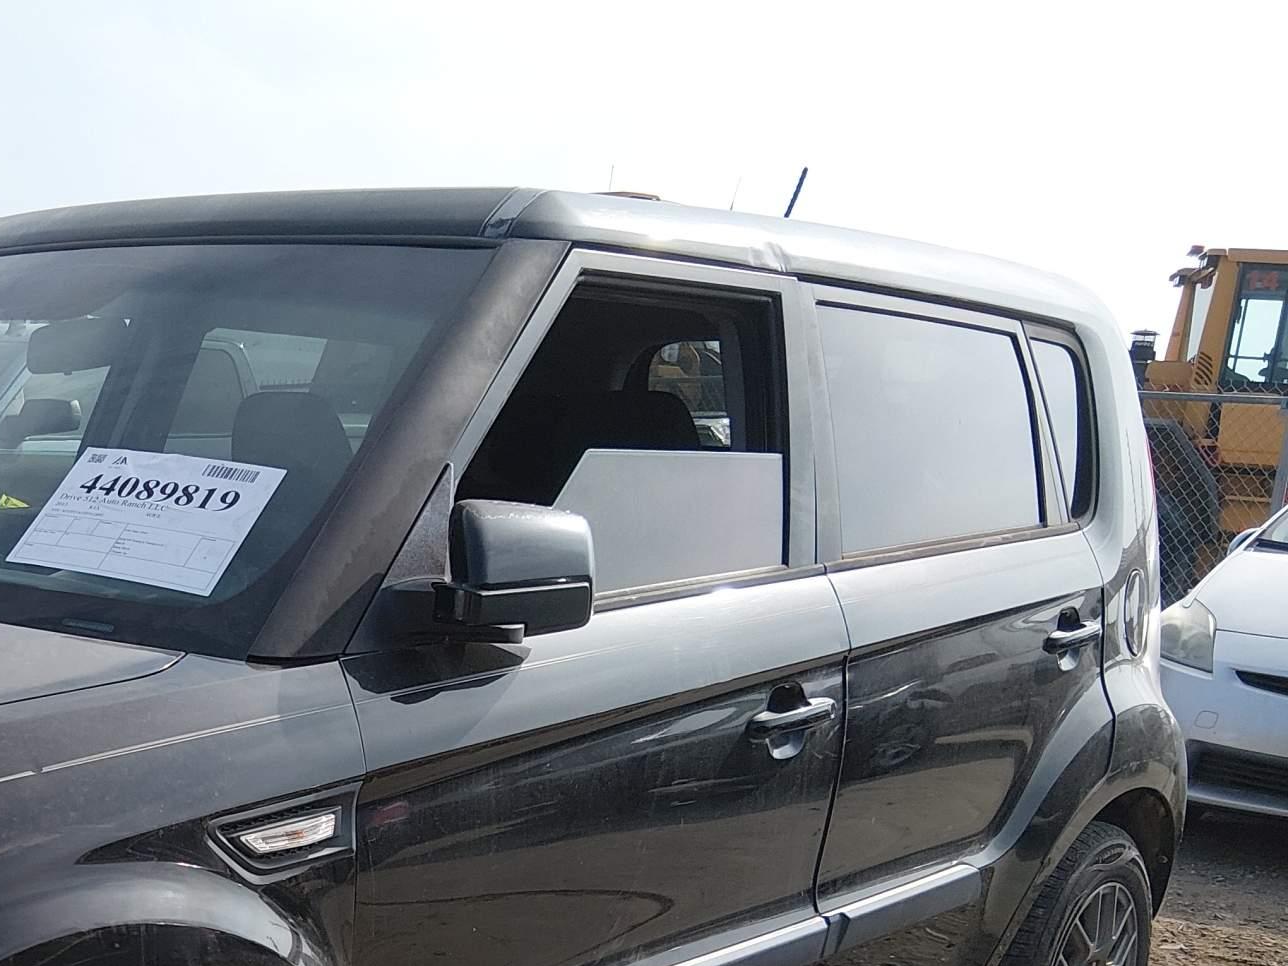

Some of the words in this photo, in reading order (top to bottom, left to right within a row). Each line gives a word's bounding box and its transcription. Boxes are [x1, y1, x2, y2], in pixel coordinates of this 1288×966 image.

[60, 492, 83, 501] Drive
[99, 496, 120, 505] Auto
[121, 499, 147, 509] Ranch
[79, 473, 241, 512] 44089819
